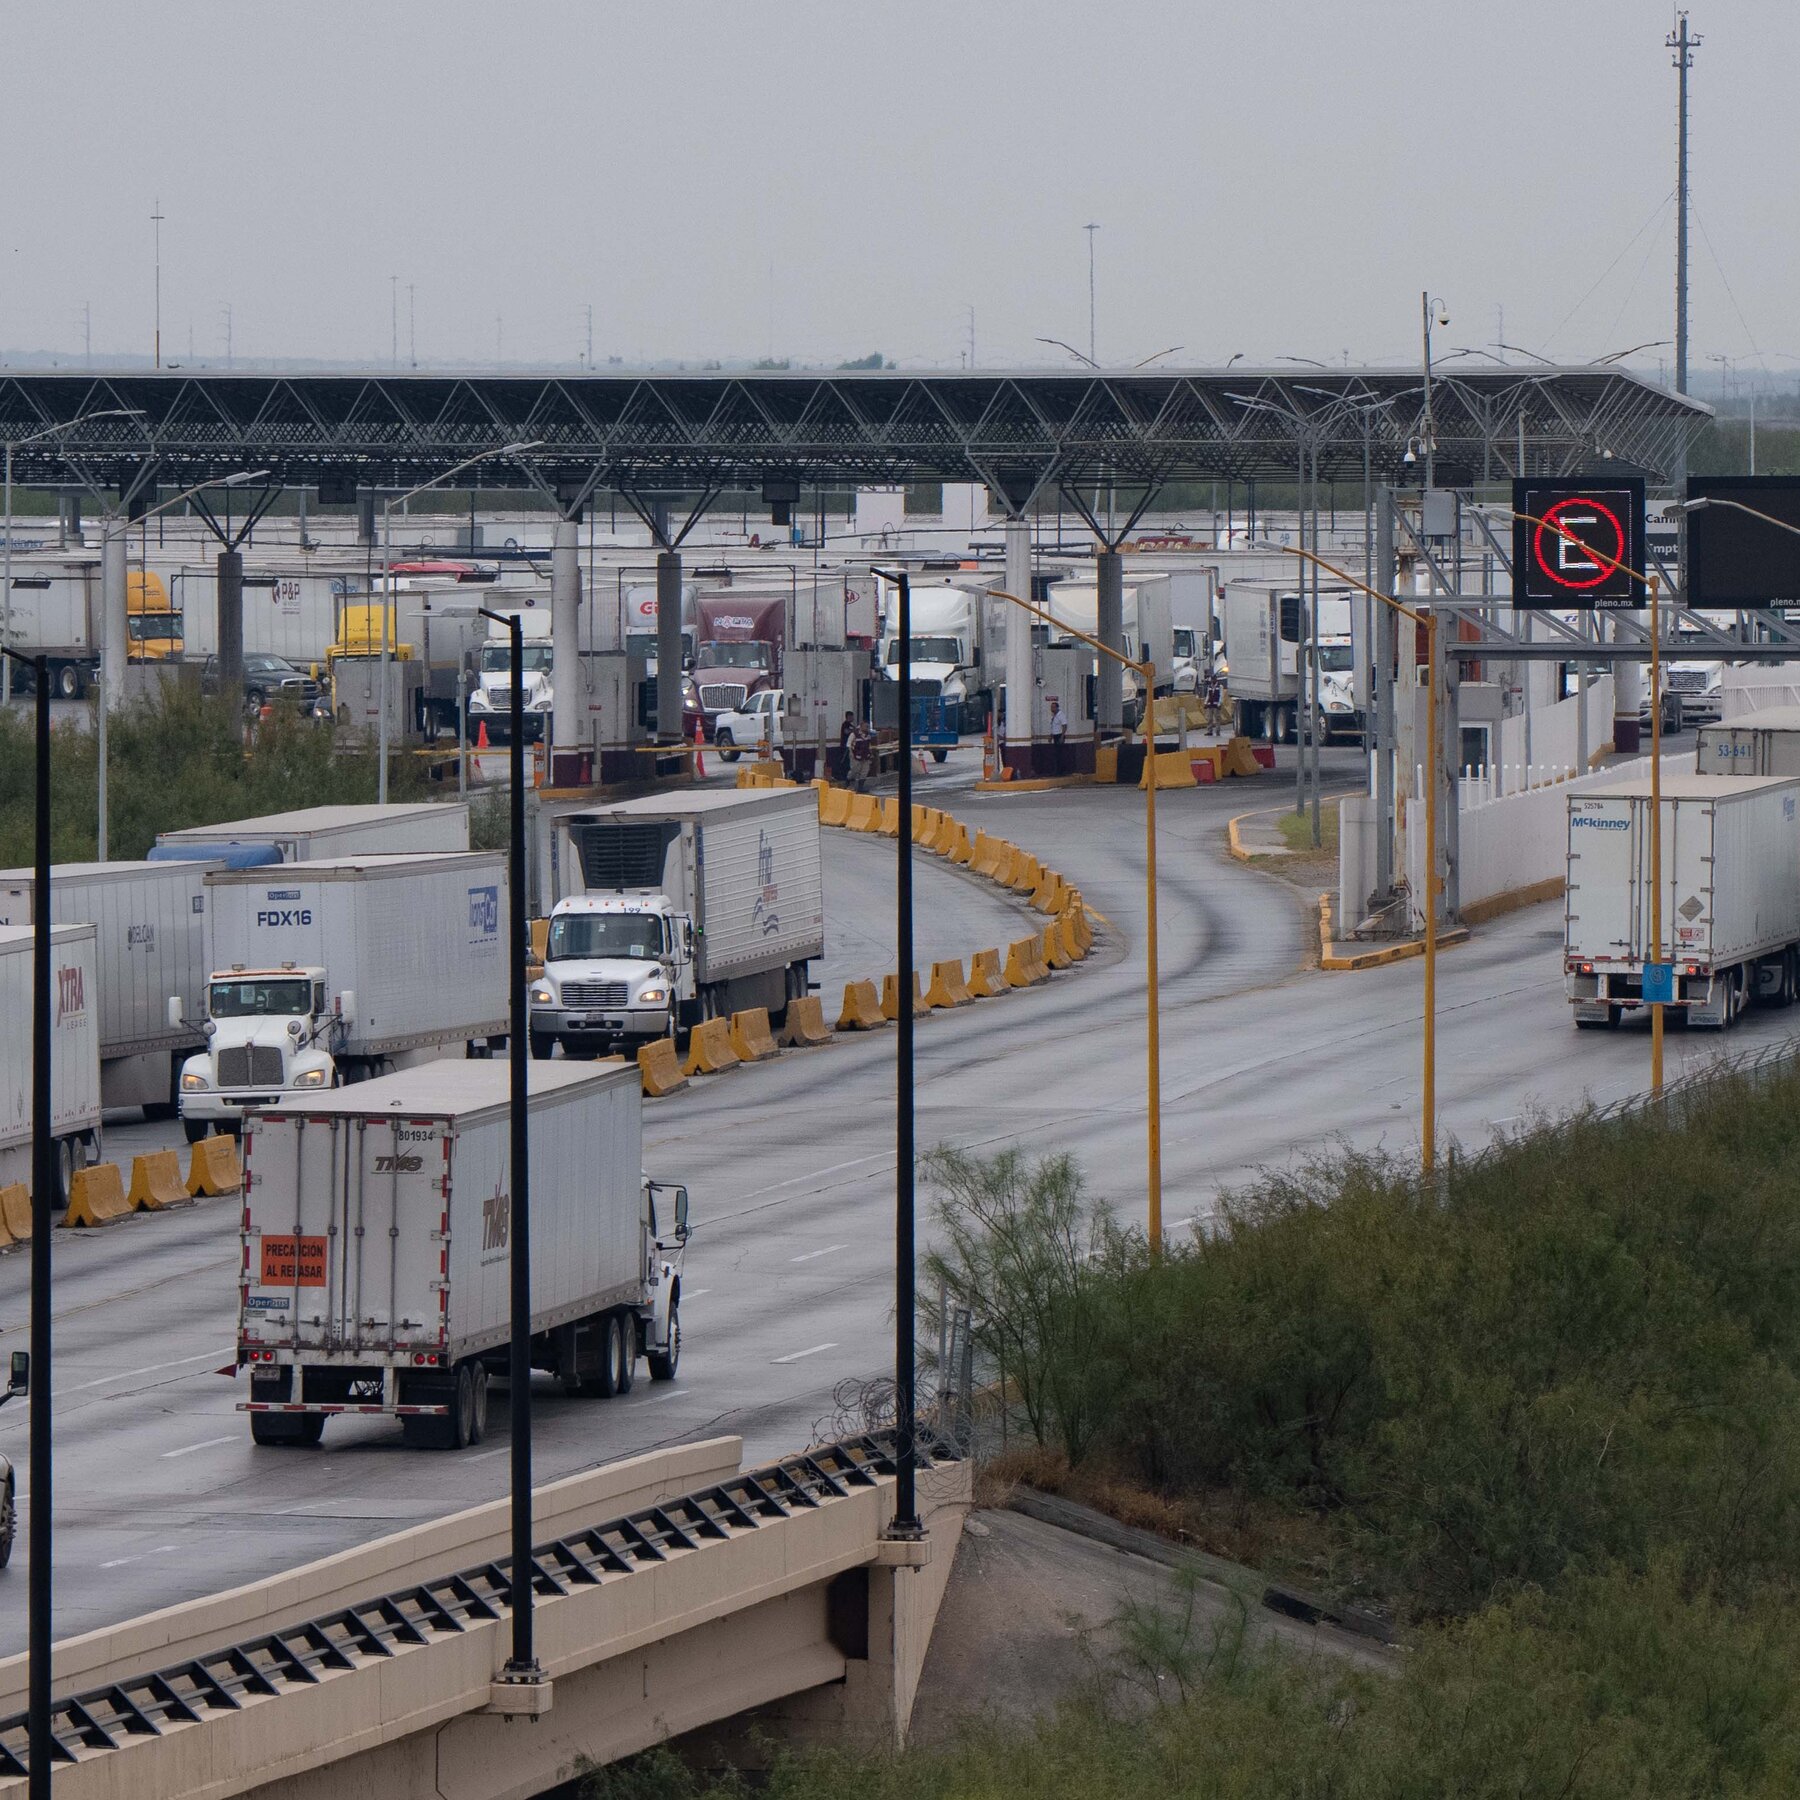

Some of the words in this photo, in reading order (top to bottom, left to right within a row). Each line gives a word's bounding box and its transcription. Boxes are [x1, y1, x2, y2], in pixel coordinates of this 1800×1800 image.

[1649, 543, 1679, 556] mpt
[1594, 599, 1634, 608] pleno.mx
[257, 909, 312, 927] FDX16
[57, 964, 85, 1028] XTRA
[398, 1130, 433, 1141] 801934
[266, 1264, 278, 1277] AL
